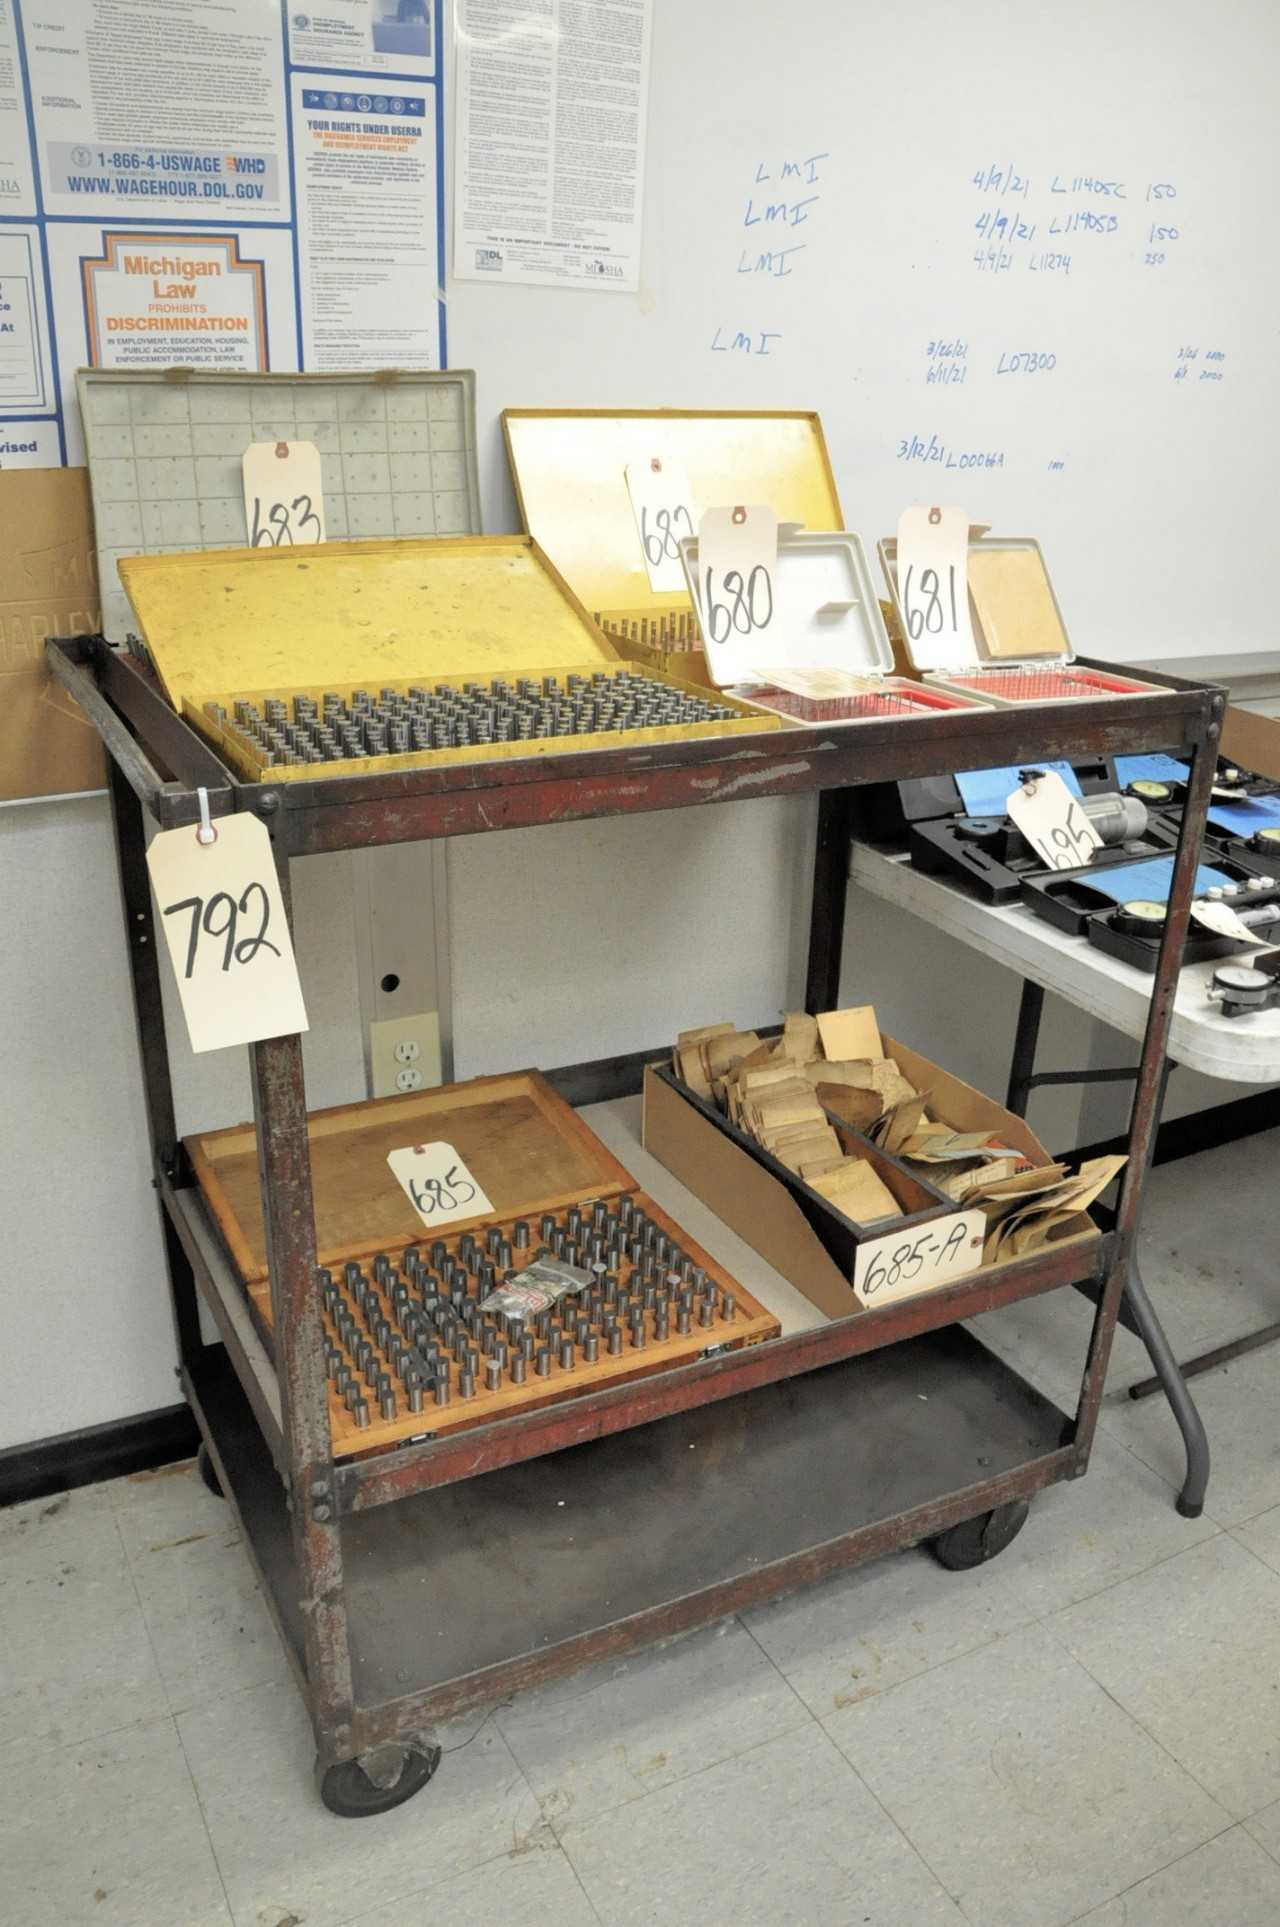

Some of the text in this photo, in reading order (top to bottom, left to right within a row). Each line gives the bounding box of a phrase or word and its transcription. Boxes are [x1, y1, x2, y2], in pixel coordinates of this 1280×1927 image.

[307, 120, 330, 130] YOUR
[331, 121, 361, 133] RIGHTS
[363, 123, 389, 135] UNDER
[98, 152, 265, 174] 1-866-4-USWAGE WHD
[67, 176, 264, 200] WWW.WAGEHOUR.DOL.GOV
[972, 163, 1177, 202] 4/9/21 L11405C 150
[744, 196, 820, 227] LMI
[974, 208, 1036, 243] 4/9/21
[1148, 224, 1180, 244] 150
[123, 255, 222, 280] Michigan
[736, 244, 808, 277] LMI
[152, 280, 196, 299] Law
[148, 304, 208, 314] PROHIBITS
[106, 317, 248, 332] DISCRIMINATION
[117, 338, 169, 346] EMPLOYMENT,
[123, 346, 150, 354] PUBLIC
[220, 346, 235, 354] LAW
[711, 328, 783, 356] LMI
[115, 355, 171, 363] ENFORCEMENT
[214, 354, 244, 362] SERVICE
[996, 352, 1057, 375] L07300
[896, 435, 944, 464] 3/12/21
[250, 494, 322, 548] 683
[706, 564, 774, 644] 680
[904, 564, 959, 640] 681
[163, 882, 282, 979] 792
[409, 1166, 476, 1214] 685
[862, 1222, 968, 1296] 685-A
